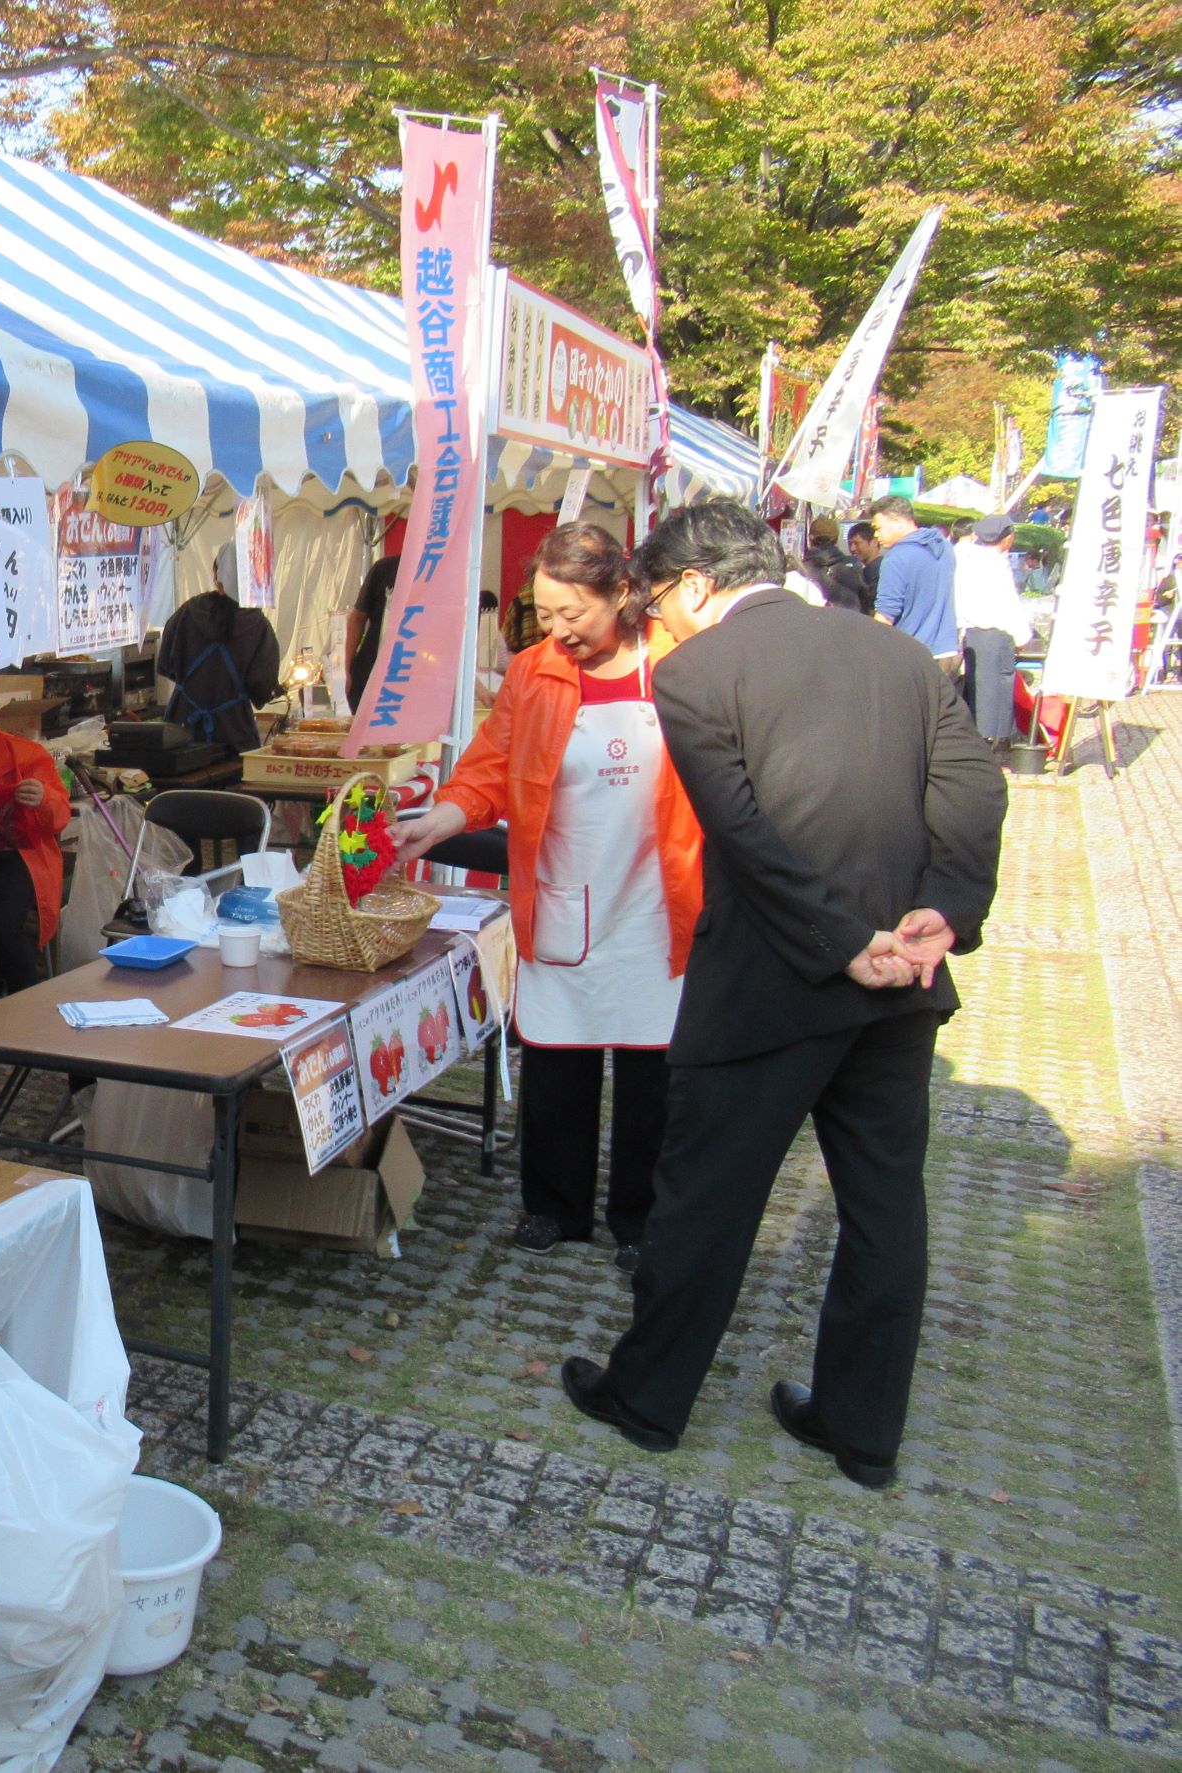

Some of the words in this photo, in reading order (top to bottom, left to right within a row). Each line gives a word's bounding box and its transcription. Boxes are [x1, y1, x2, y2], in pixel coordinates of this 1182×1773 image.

[415, 247, 461, 582] 越谷商工会議所
[1084, 453, 1123, 657] 七色唐辛子
